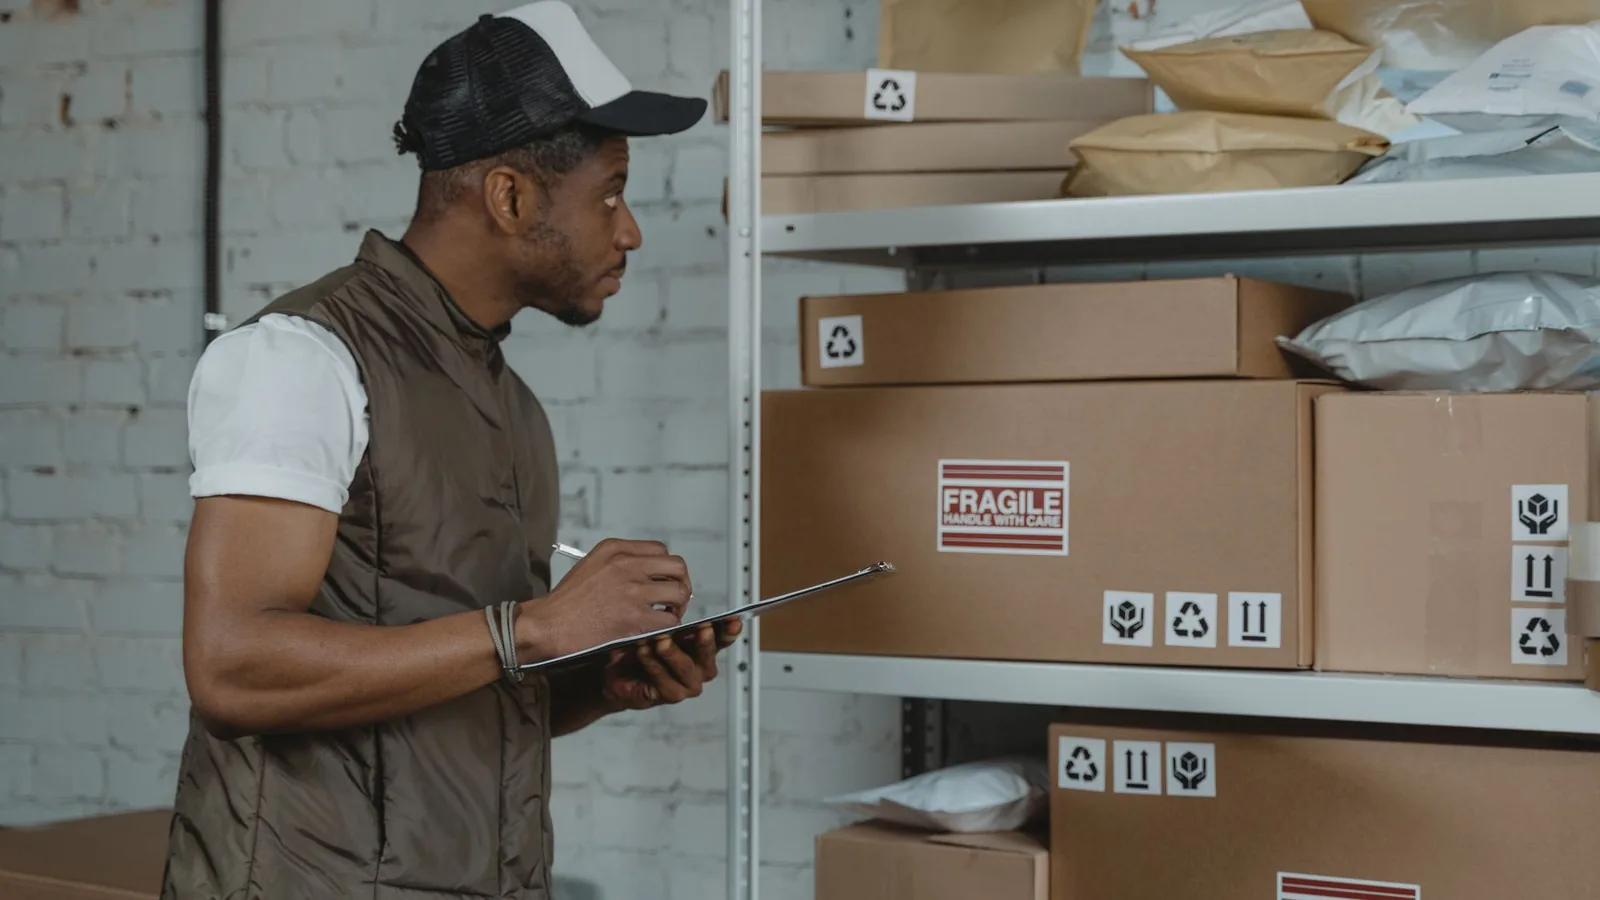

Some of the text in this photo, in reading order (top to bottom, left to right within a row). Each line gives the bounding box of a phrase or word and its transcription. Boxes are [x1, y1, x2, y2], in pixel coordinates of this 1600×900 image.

[943, 489, 1061, 515] FRAGILE
[943, 513, 1061, 527] HANDLE WITH CARE
